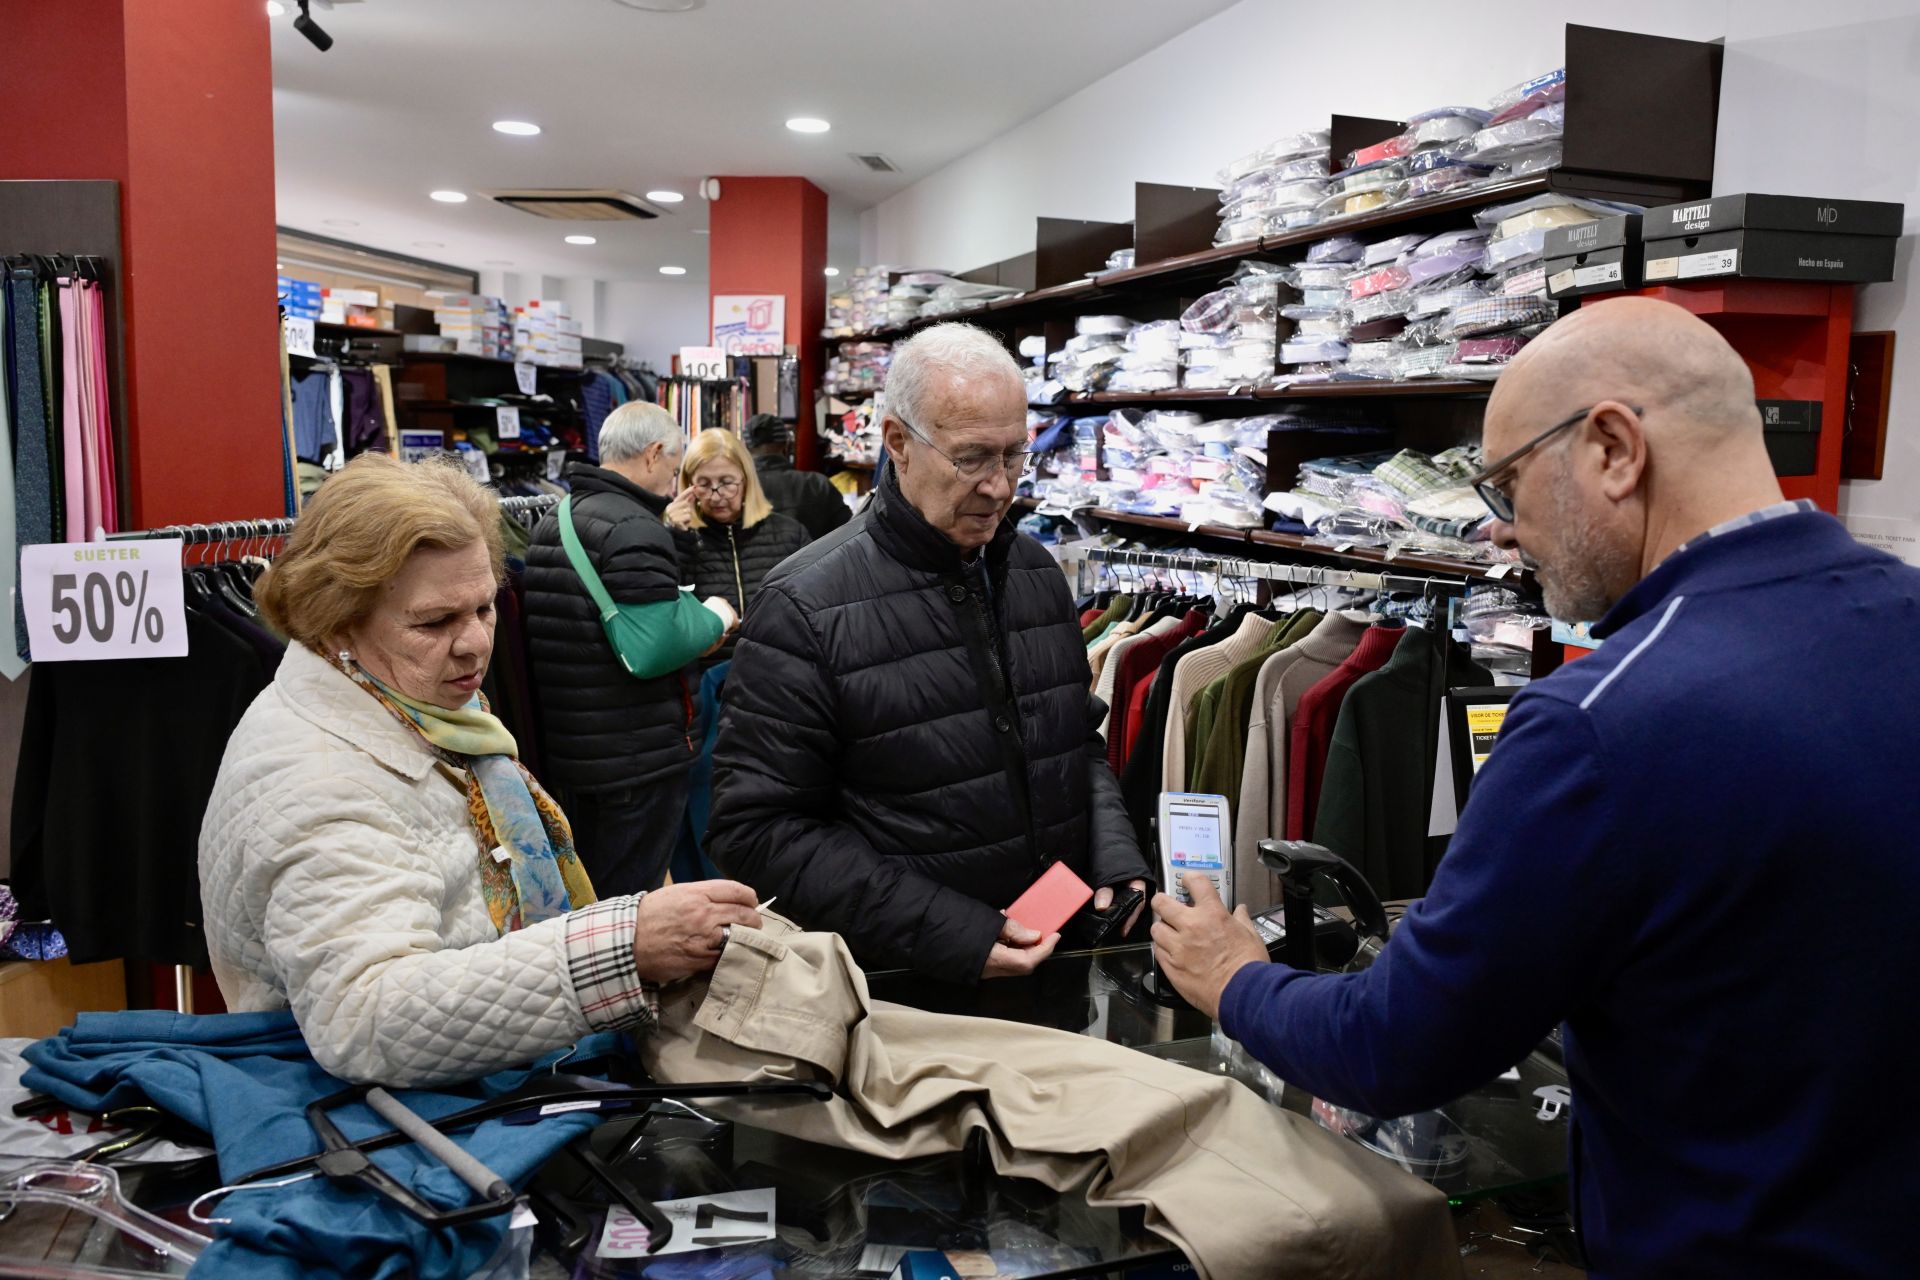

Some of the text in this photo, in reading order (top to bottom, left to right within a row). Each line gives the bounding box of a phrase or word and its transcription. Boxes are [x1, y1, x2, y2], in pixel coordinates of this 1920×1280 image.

[1672, 204, 1712, 224] MARTTELY
[1684, 220, 1710, 230] design
[1568, 224, 1599, 242] MARTTELY
[1577, 239, 1597, 248] design
[1721, 258, 1732, 269] 39
[1798, 257, 1815, 267] Hecho
[1824, 258, 1844, 270] España
[1608, 270, 1618, 279] 46
[685, 363, 721, 378] 10€
[74, 548, 141, 562] SUETER
[52, 570, 164, 644] 50%
[691, 1203, 769, 1247] 17
